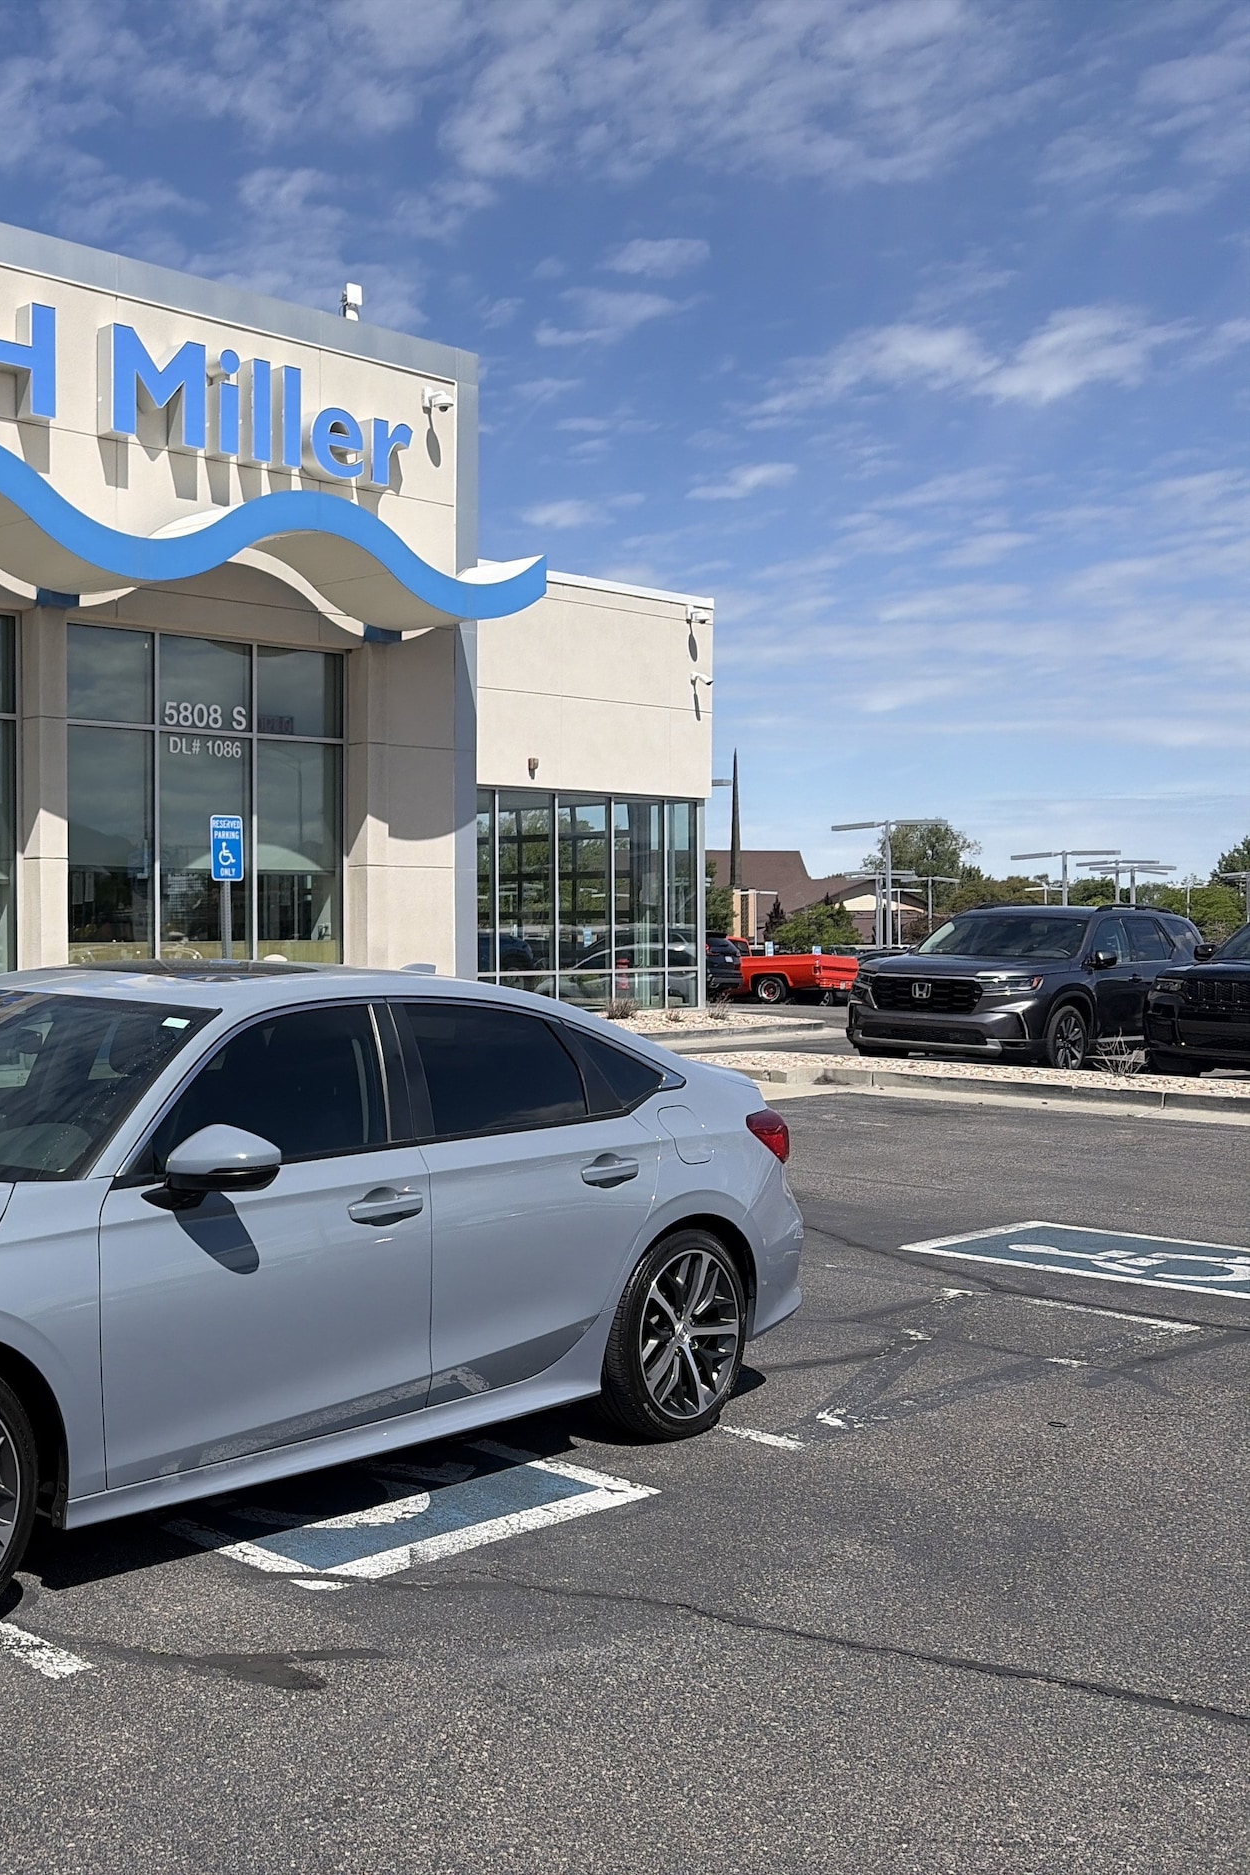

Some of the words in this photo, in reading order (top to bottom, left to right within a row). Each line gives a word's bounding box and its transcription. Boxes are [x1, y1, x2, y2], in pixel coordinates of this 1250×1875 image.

[107, 322, 414, 488] Miller
[164, 701, 222, 728] 5808
[232, 706, 247, 730] S
[169, 736, 201, 755] DL#
[206, 740, 242, 758] 1086
[212, 819, 241, 830] RESERVED
[214, 830, 240, 840] PARKING
[220, 867, 236, 877] ONLY
